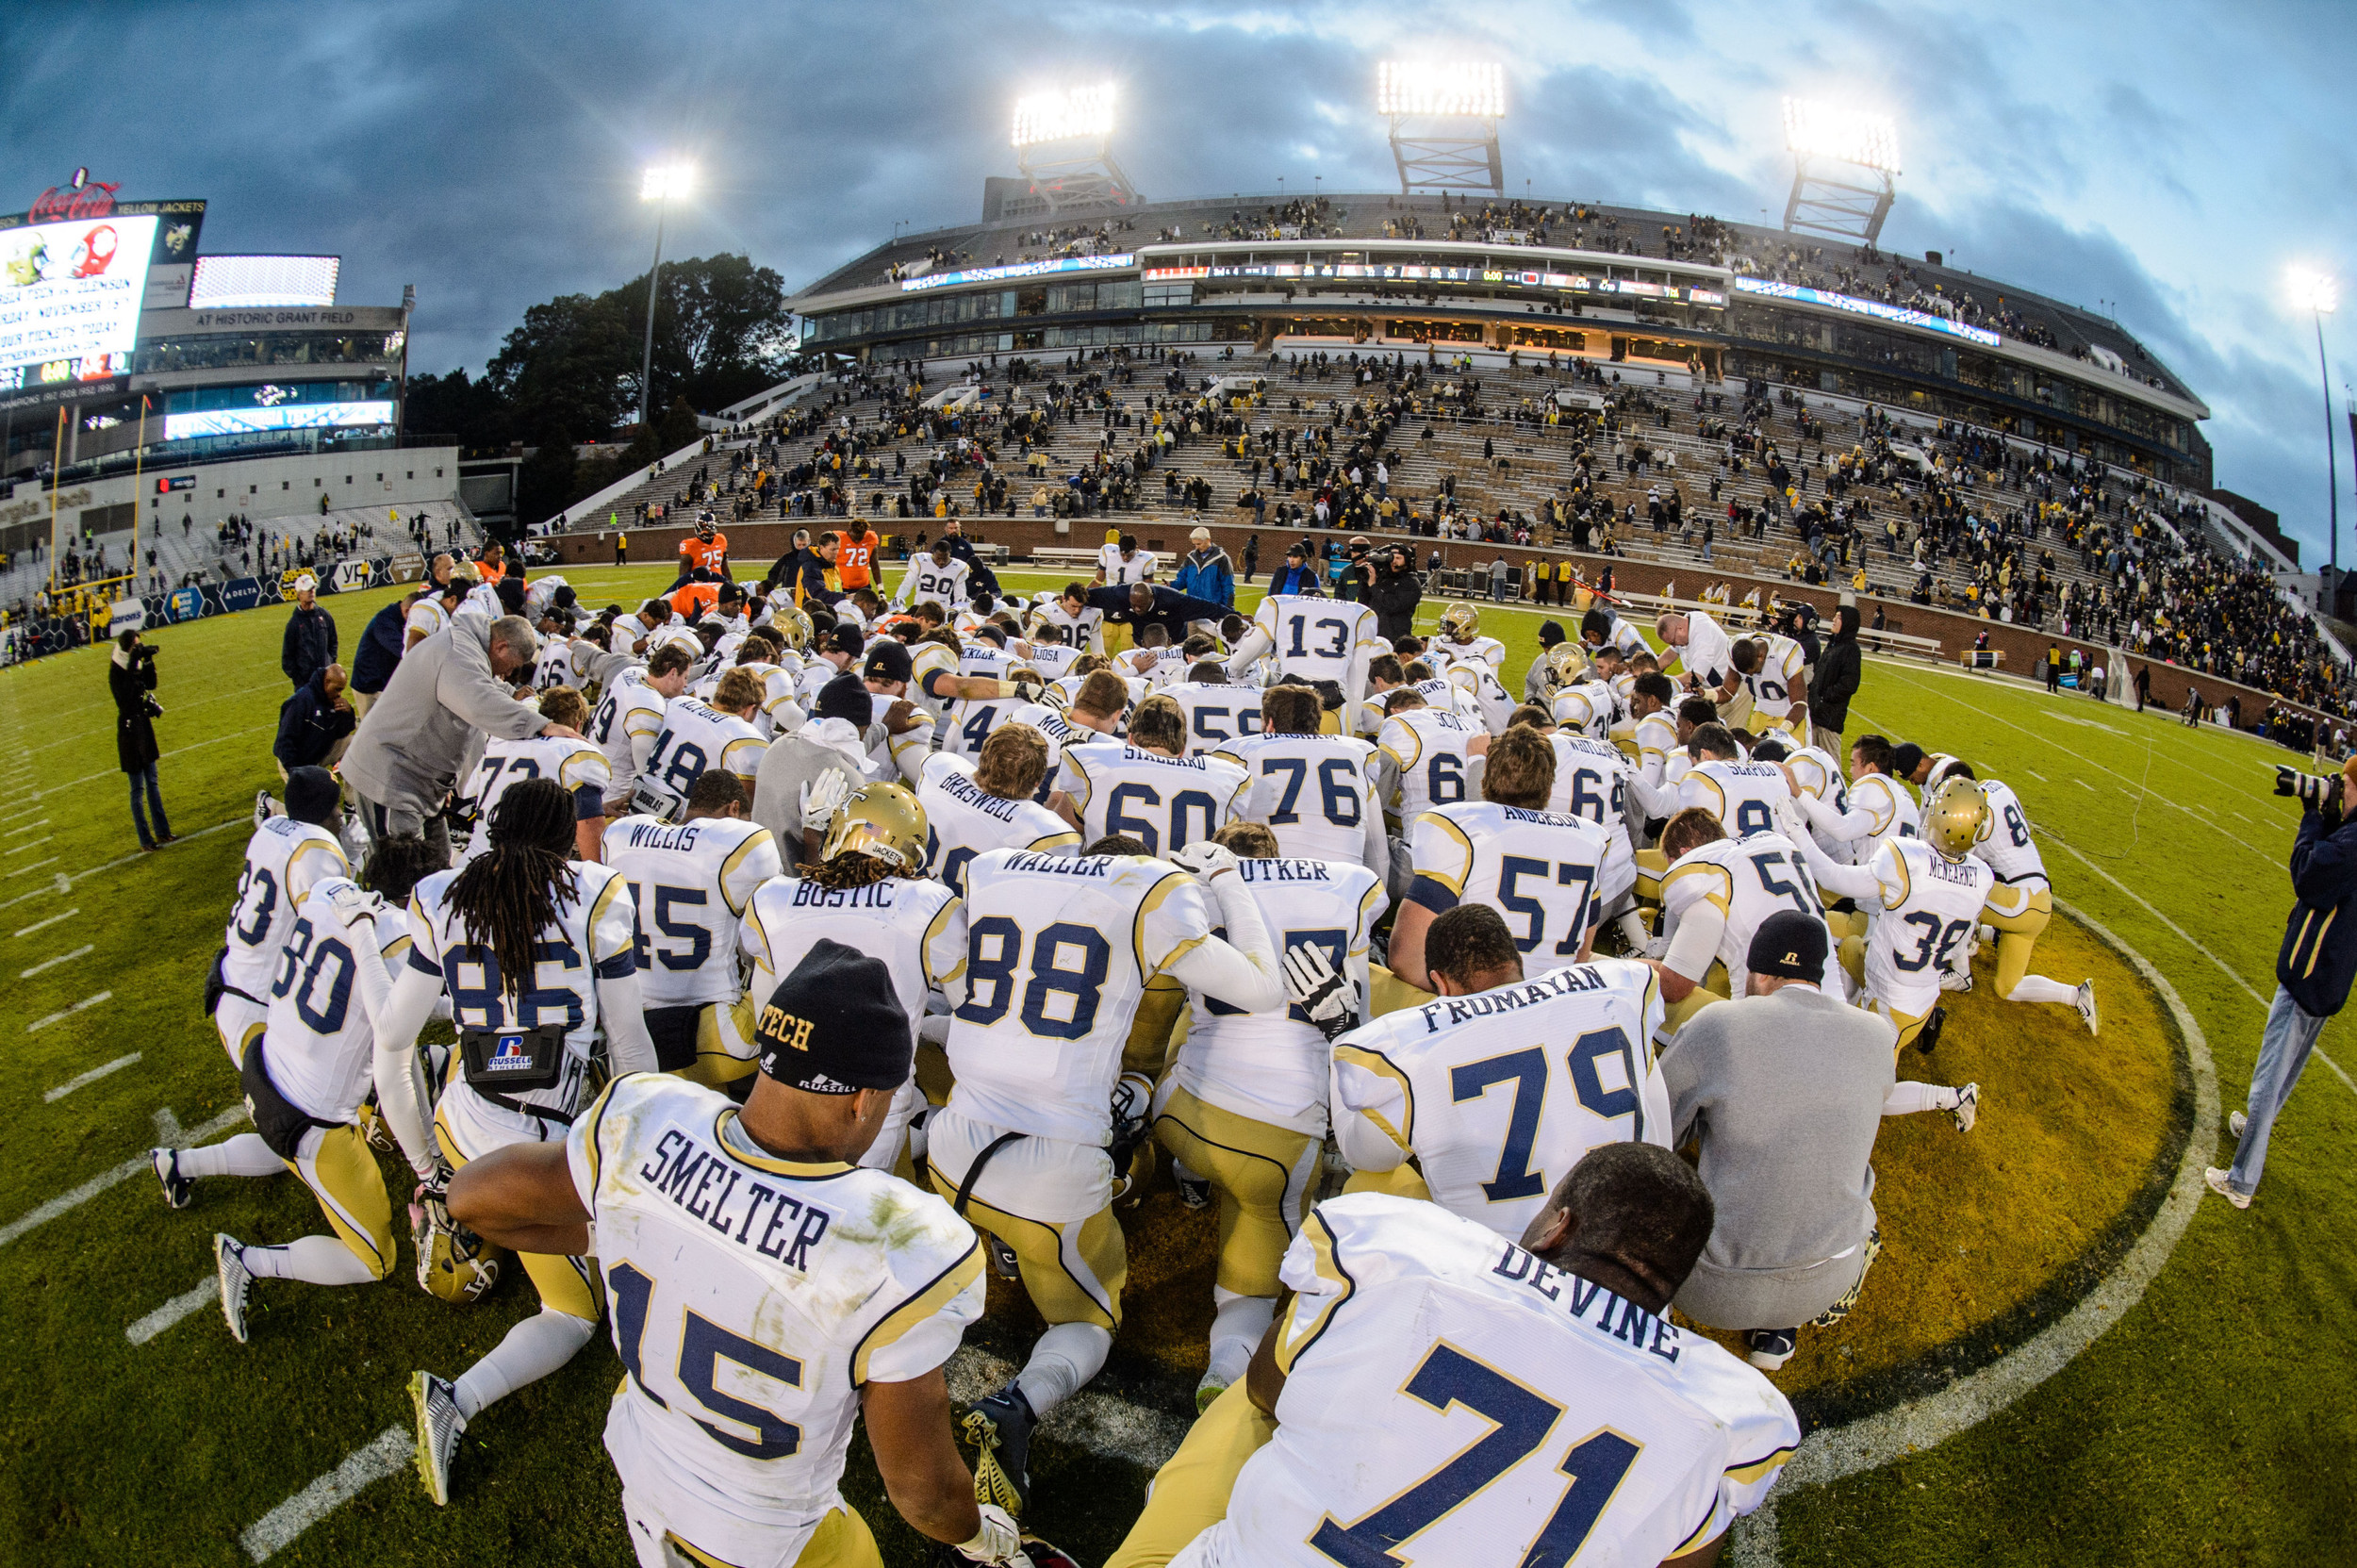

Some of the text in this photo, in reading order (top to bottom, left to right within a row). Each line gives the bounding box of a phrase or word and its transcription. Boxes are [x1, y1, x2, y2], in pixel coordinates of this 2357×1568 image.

[117, 201, 205, 216] YELLOW JACKETS
[1483, 271, 1503, 281] 0:00
[40, 300, 102, 318] NOVEMBER
[196, 311, 354, 326] AT HISTORIC GRANT FIELD
[701, 548, 722, 571] 75
[845, 547, 868, 566] 72
[919, 573, 955, 595] 20
[1117, 566, 1127, 585] 1
[232, 586, 258, 598] DELTA
[1061, 622, 1091, 652] 96
[1287, 614, 1349, 659] 13
[677, 700, 730, 724] ALFORD
[645, 728, 708, 799] 48
[1261, 757, 1360, 828] 76
[1427, 751, 1466, 806] 6
[635, 789, 665, 813] DOUGLAS
[938, 771, 1022, 825] BRASWELL
[1105, 782, 1218, 858] 60
[1504, 806, 1581, 831] ANDERSON
[629, 824, 701, 852] WILLIS
[889, 835, 897, 845] 7
[872, 844, 903, 865] JACKETS
[1001, 850, 1114, 878] WALLER
[1929, 854, 1978, 889] McNEARNEY
[792, 881, 896, 909] BOSTIC
[1496, 852, 1595, 955] 57
[1892, 909, 1972, 973] 38
[440, 939, 586, 1033] 86
[951, 913, 1112, 1044] 88
[1420, 963, 1607, 1033] FROMAYAN
[757, 1003, 816, 1052] TECH
[486, 1064, 533, 1072] ATHLETIC
[488, 1056, 533, 1065] RUSSELL
[798, 1080, 857, 1094] RUSSELL
[1447, 1023, 1646, 1204] 79
[638, 1129, 830, 1273] SMELTER
[1492, 1240, 1681, 1365] DEVINE
[607, 1256, 807, 1463] 15
[1303, 1335, 1646, 1568] 71
